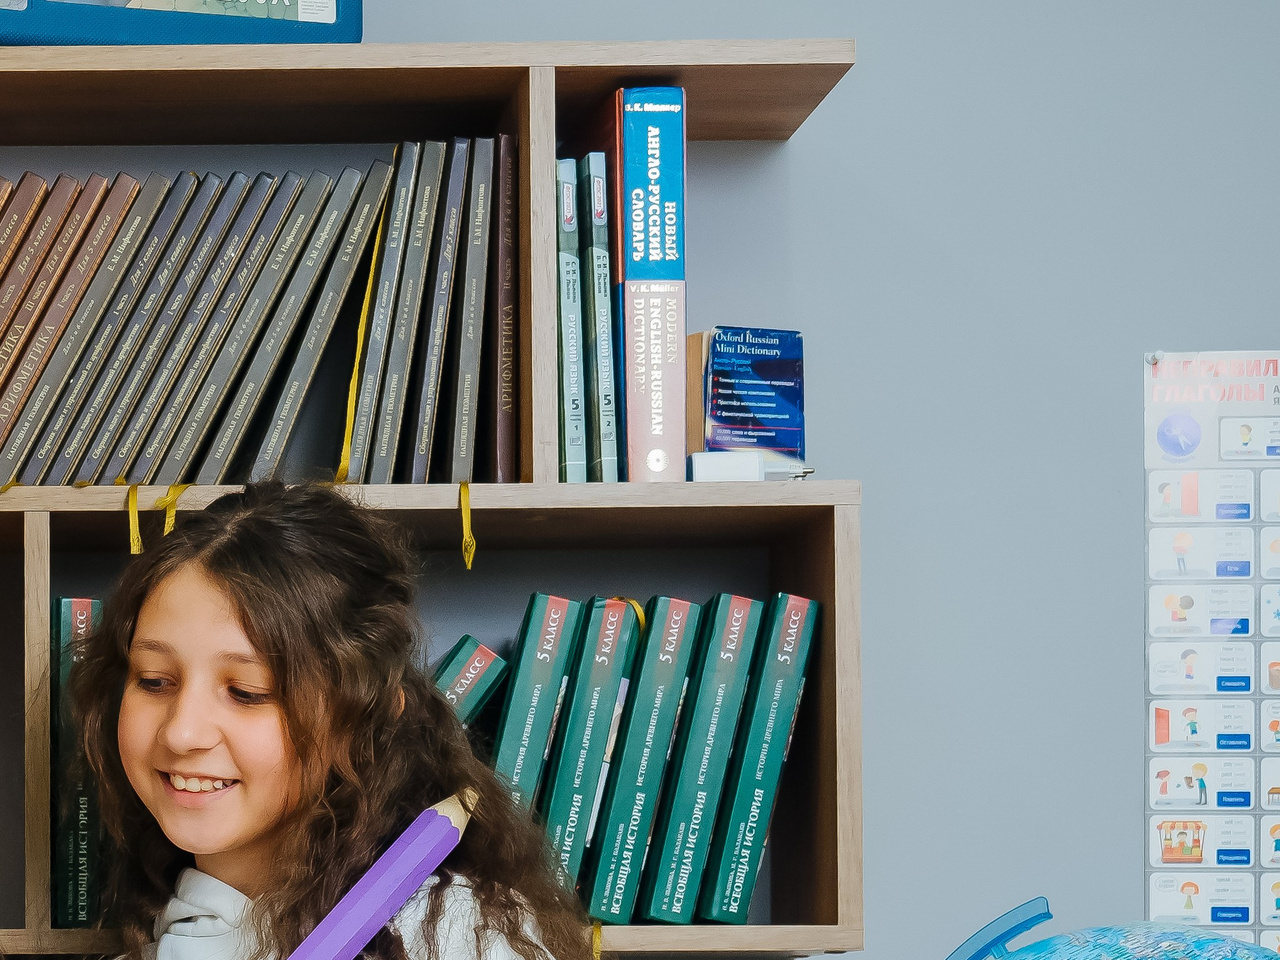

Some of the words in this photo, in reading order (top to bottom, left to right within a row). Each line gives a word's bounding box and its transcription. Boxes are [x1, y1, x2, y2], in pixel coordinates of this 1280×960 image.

[647, 125, 663, 262] АНГЛО-РУССКИЙ
[0, 213, 19, 246] класса
[16, 254, 31, 275] Для
[28, 246, 35, 254] 5
[33, 215, 53, 247] класса
[76, 253, 90, 275] Для
[87, 246, 94, 254] 5
[92, 214, 112, 247] класса
[141, 234, 161, 263] класса
[632, 188, 645, 262] СЛОВАРЬ
[664, 201, 679, 261] НОВЫЙ
[31, 279, 47, 300] часть
[45, 252, 59, 274] Для
[62, 213, 82, 245] класса
[127, 266, 143, 287] Для
[137, 259, 147, 269] 5
[114, 292, 130, 313] часть
[568, 313, 579, 366] РУССКИЙ
[599, 308, 611, 360] РУССКИЙ
[666, 297, 678, 364] MODERN
[715, 331, 744, 343] Oxford
[746, 331, 780, 345] Russian
[715, 343, 735, 354] Mini
[737, 344, 782, 358] Dictionary
[501, 304, 514, 413] АРИФМЕТИКА
[569, 367, 579, 397] ЯЗЫК
[601, 361, 611, 390] ЯЗЫК
[649, 297, 663, 435] ENGLISH-RUSSIAN
[571, 398, 580, 410] 5
[603, 393, 612, 406] 5
[1152, 384, 1265, 402] ГЛАГОЛЫ
[536, 652, 550, 663] 5
[544, 608, 562, 652] КЛАСС
[595, 655, 609, 666] 5
[602, 611, 619, 655] КЛАСС
[659, 653, 673, 665] 5
[666, 610, 683, 653] КЛАСС
[720, 651, 734, 663] 5
[727, 608, 744, 652] КЛАСС
[777, 653, 791, 665] 5
[785, 610, 802, 654] КЛАСС
[445, 690, 458, 705] 5
[455, 656, 485, 694] КЛАСС
[512, 746, 527, 786] ИСТОРИЯ
[521, 707, 537, 748] ДРЕВНЕГО
[530, 683, 542, 707] МИРА
[635, 751, 652, 787] ИСТОРИЯ
[645, 709, 659, 751] ДРЕВНЕГО
[654, 684, 665, 710] МИРА
[755, 746, 771, 781] ИСТОРИЯ
[766, 703, 779, 746] ДРЕВНЕГО
[774, 679, 784, 704] МИРА
[561, 793, 583, 851] ИСТОРИЯ
[609, 850, 633, 915] ВСЕОБЩАЯ
[625, 792, 647, 850] ИСТОРИЯ
[672, 849, 694, 914] ВСЕОБЩАЯ
[686, 791, 707, 848] ИСТОРИЯ
[728, 848, 751, 914] ВСЕОБЩАЯ
[743, 788, 765, 847] ИСТОРИЯ
